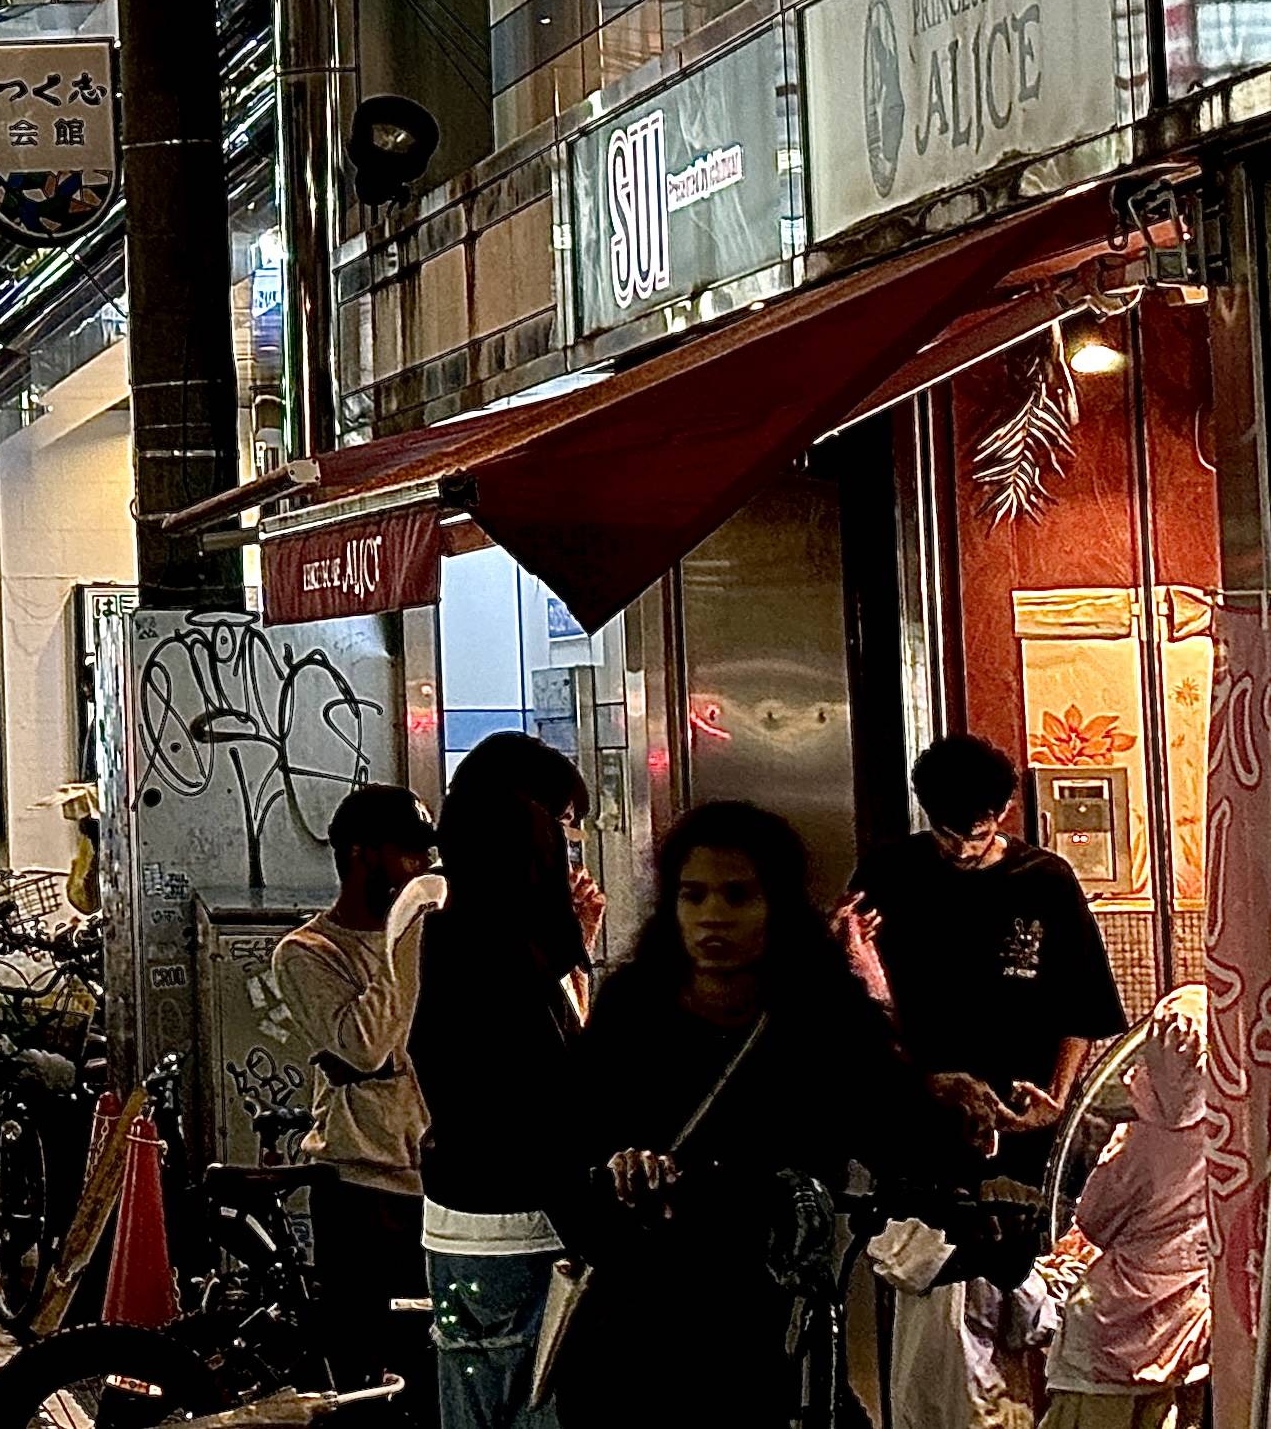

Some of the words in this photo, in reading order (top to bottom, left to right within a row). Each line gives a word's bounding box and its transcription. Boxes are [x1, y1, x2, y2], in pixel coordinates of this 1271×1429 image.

[9, 118, 85, 146] 会館
[915, 3, 1041, 156] ALICE
[607, 108, 669, 309] SUI
